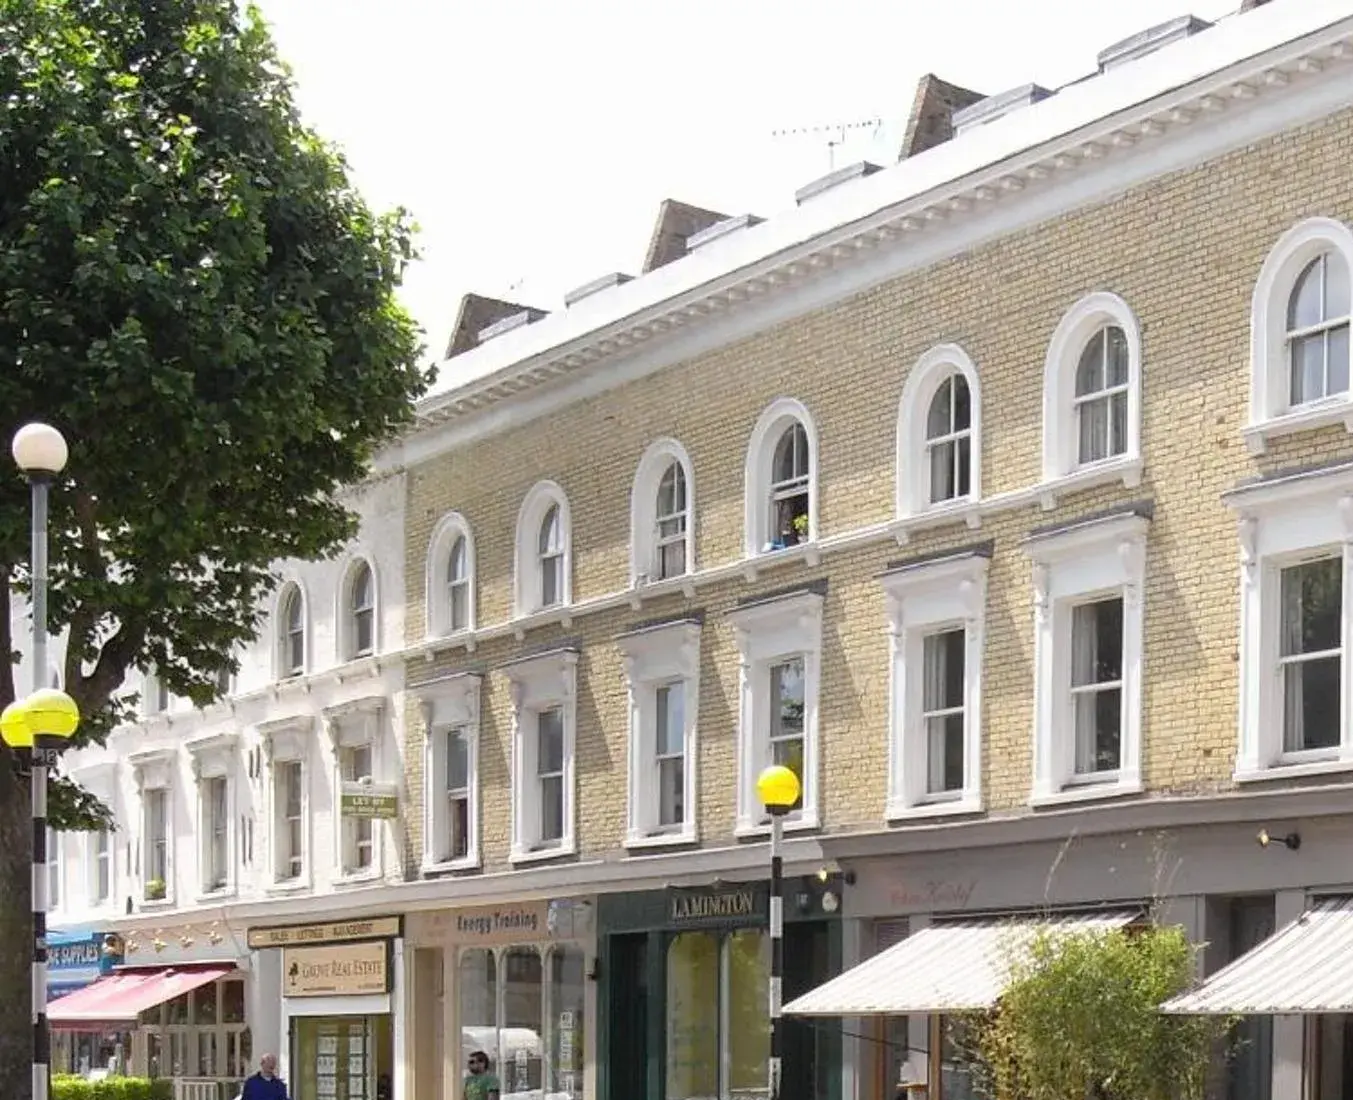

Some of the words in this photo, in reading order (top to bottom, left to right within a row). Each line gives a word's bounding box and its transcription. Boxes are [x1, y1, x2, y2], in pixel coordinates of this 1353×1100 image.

[672, 891, 753, 918] LAMINGTON
[457, 914, 491, 935] Energy
[494, 910, 538, 931] Training
[353, 959, 382, 976] ESTATE
